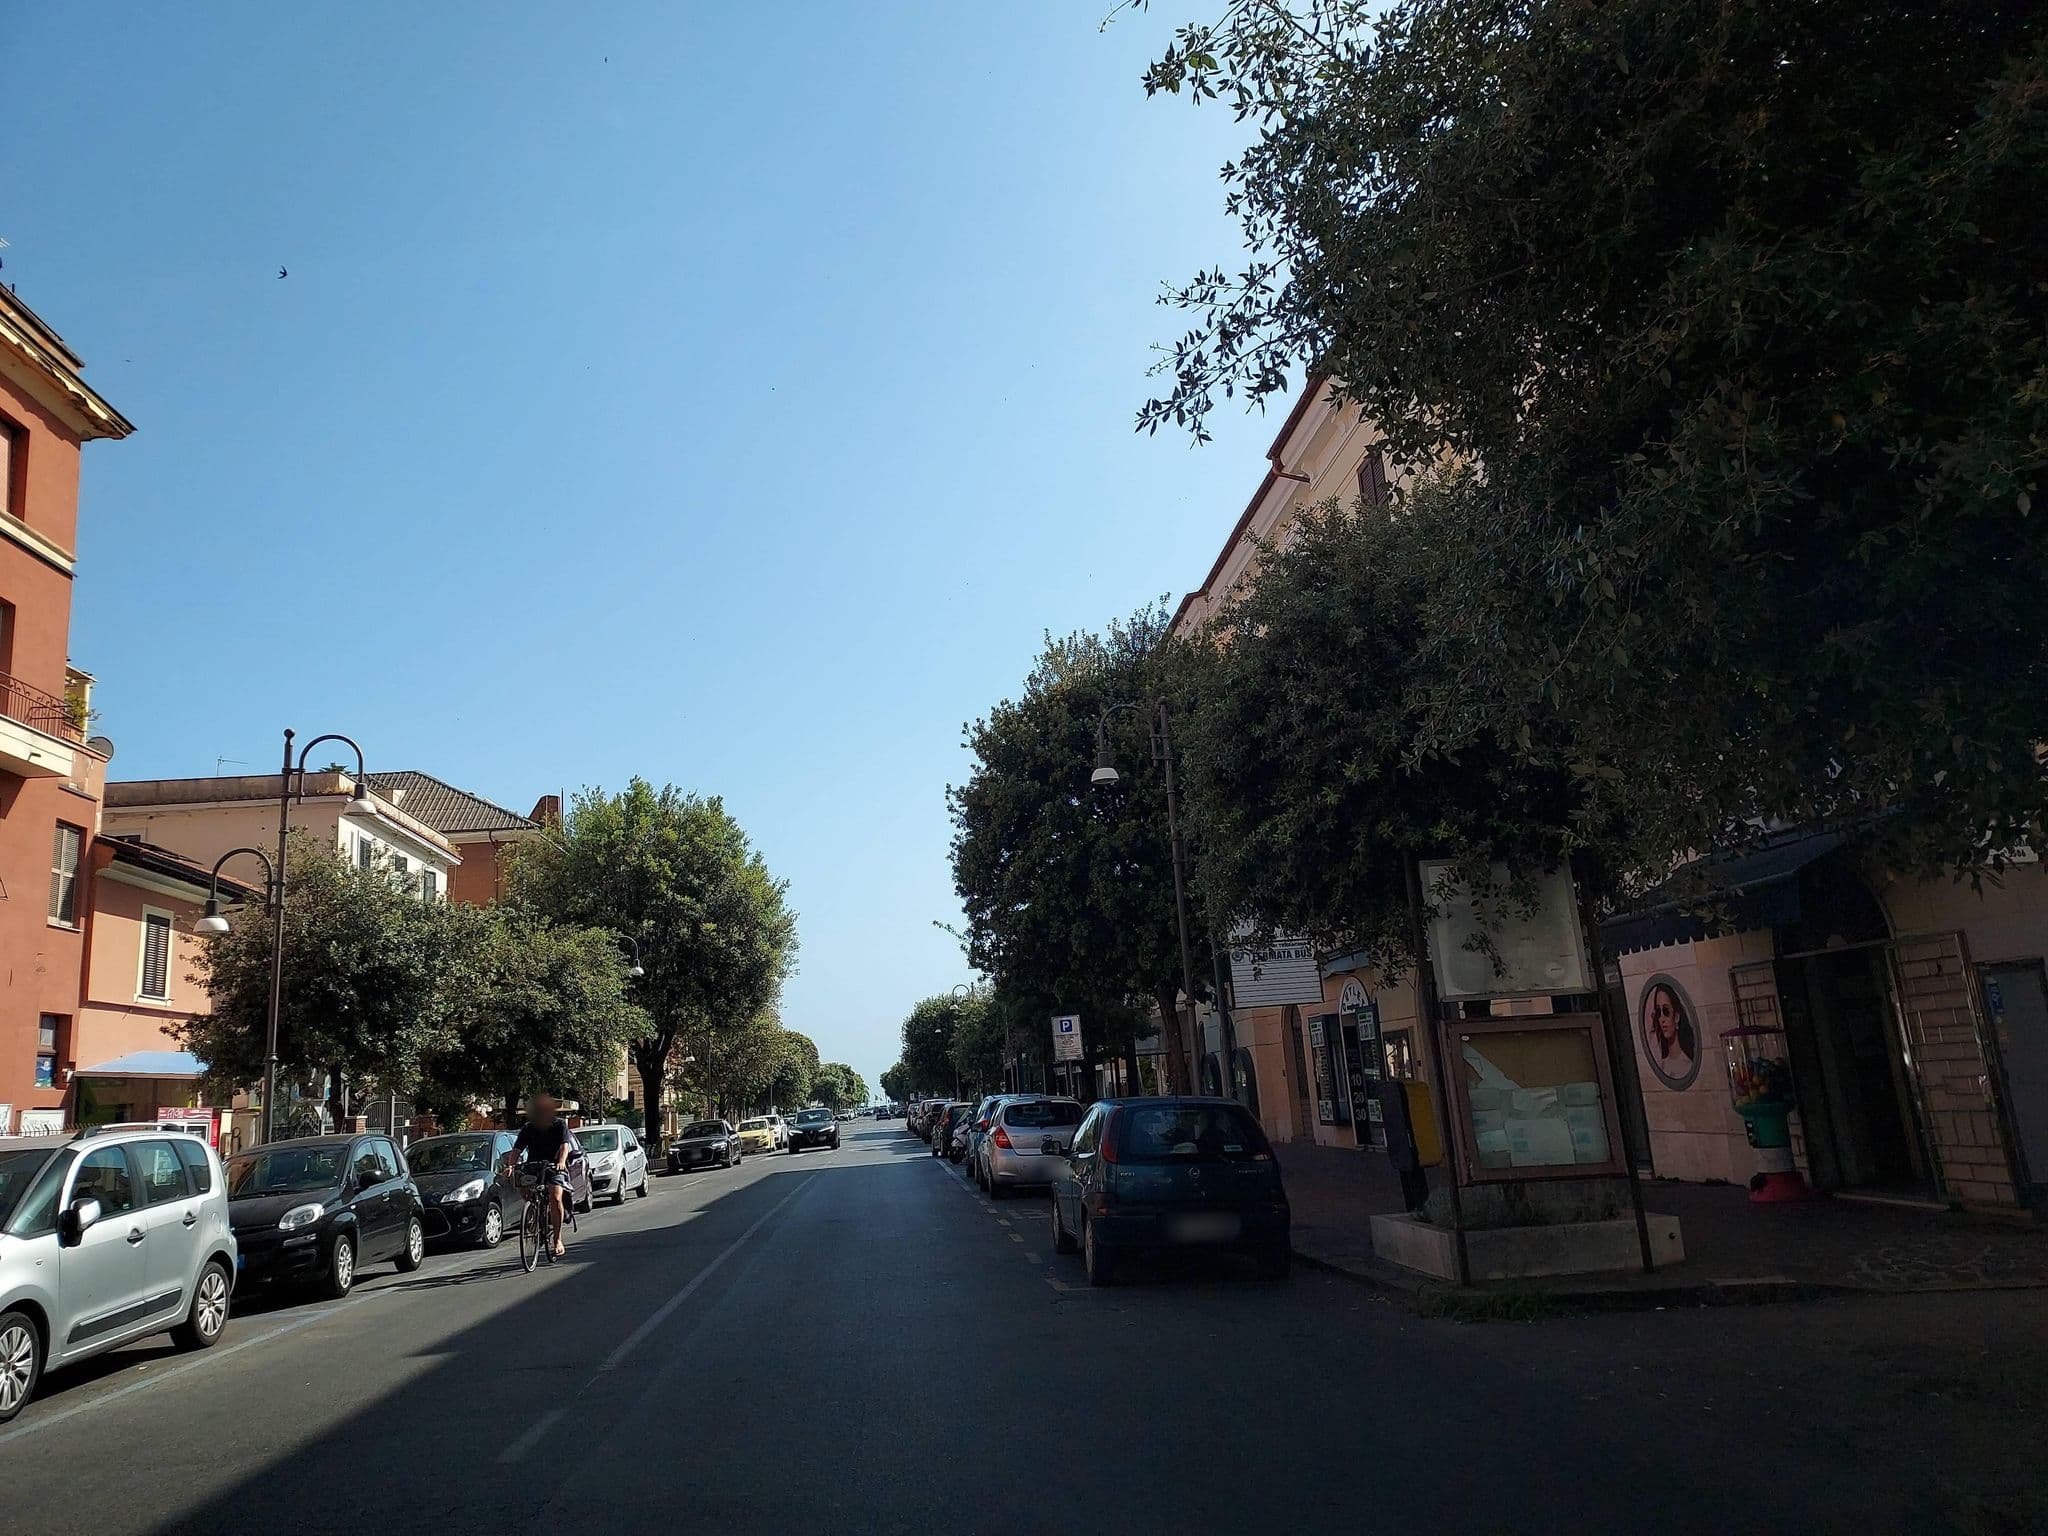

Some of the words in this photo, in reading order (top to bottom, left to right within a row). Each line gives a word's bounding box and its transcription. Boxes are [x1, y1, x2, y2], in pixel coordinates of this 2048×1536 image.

[1294, 949, 1313, 959] BUS
[1350, 1073, 1362, 1087] 10
[1353, 1091, 1365, 1104] 20
[1355, 1108, 1367, 1121] 30
